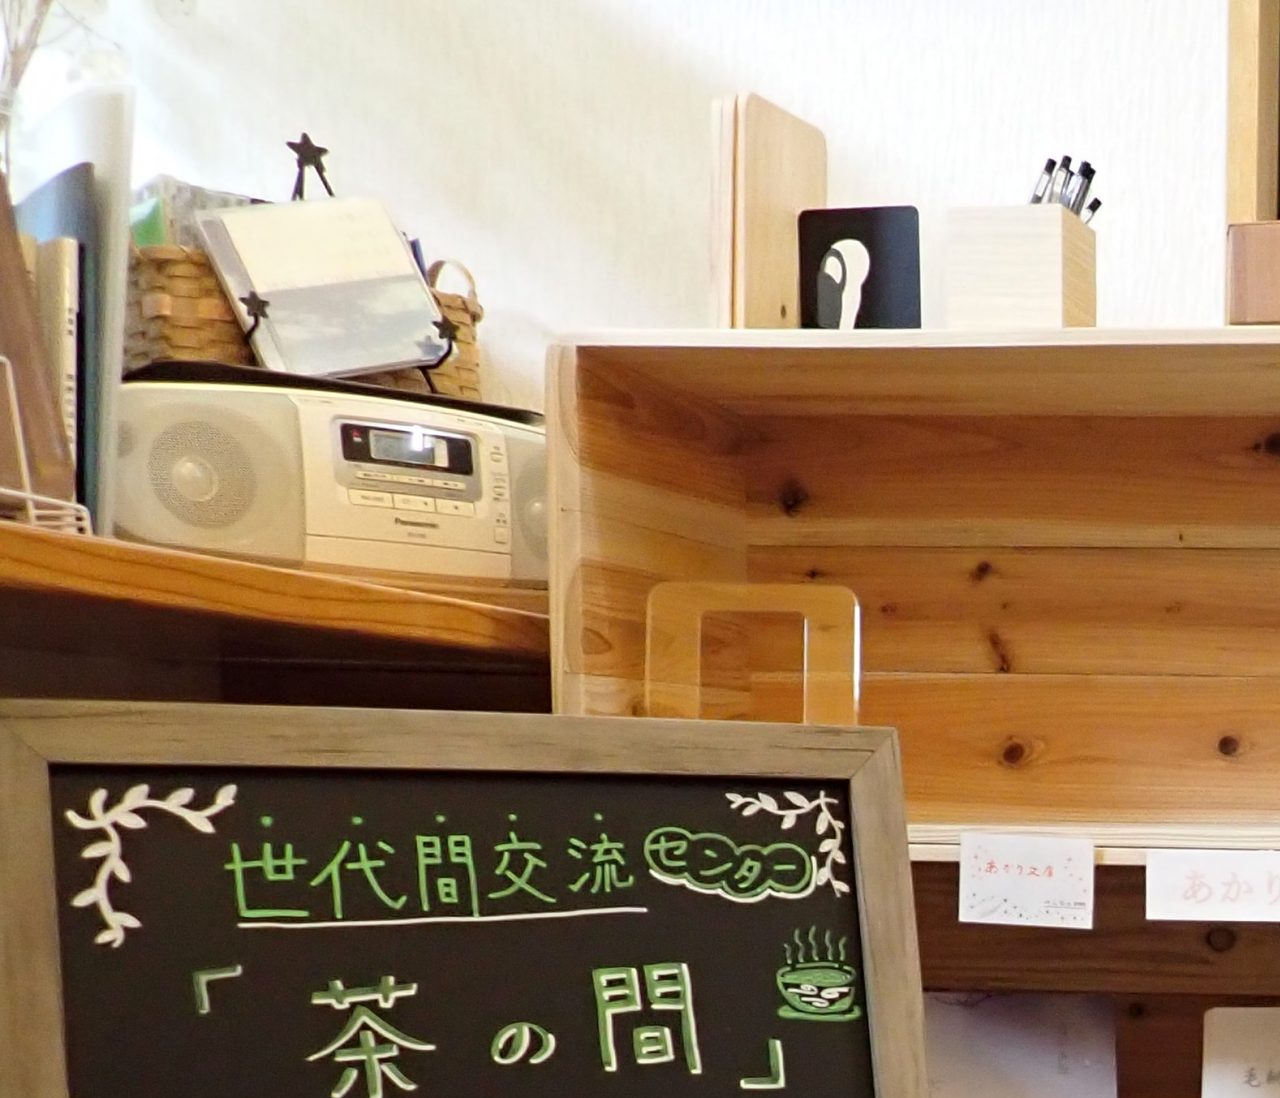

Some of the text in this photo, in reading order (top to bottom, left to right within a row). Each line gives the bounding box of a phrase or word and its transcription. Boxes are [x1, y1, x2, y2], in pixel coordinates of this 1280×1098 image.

[225, 831, 800, 919] 世代間交流 センター
